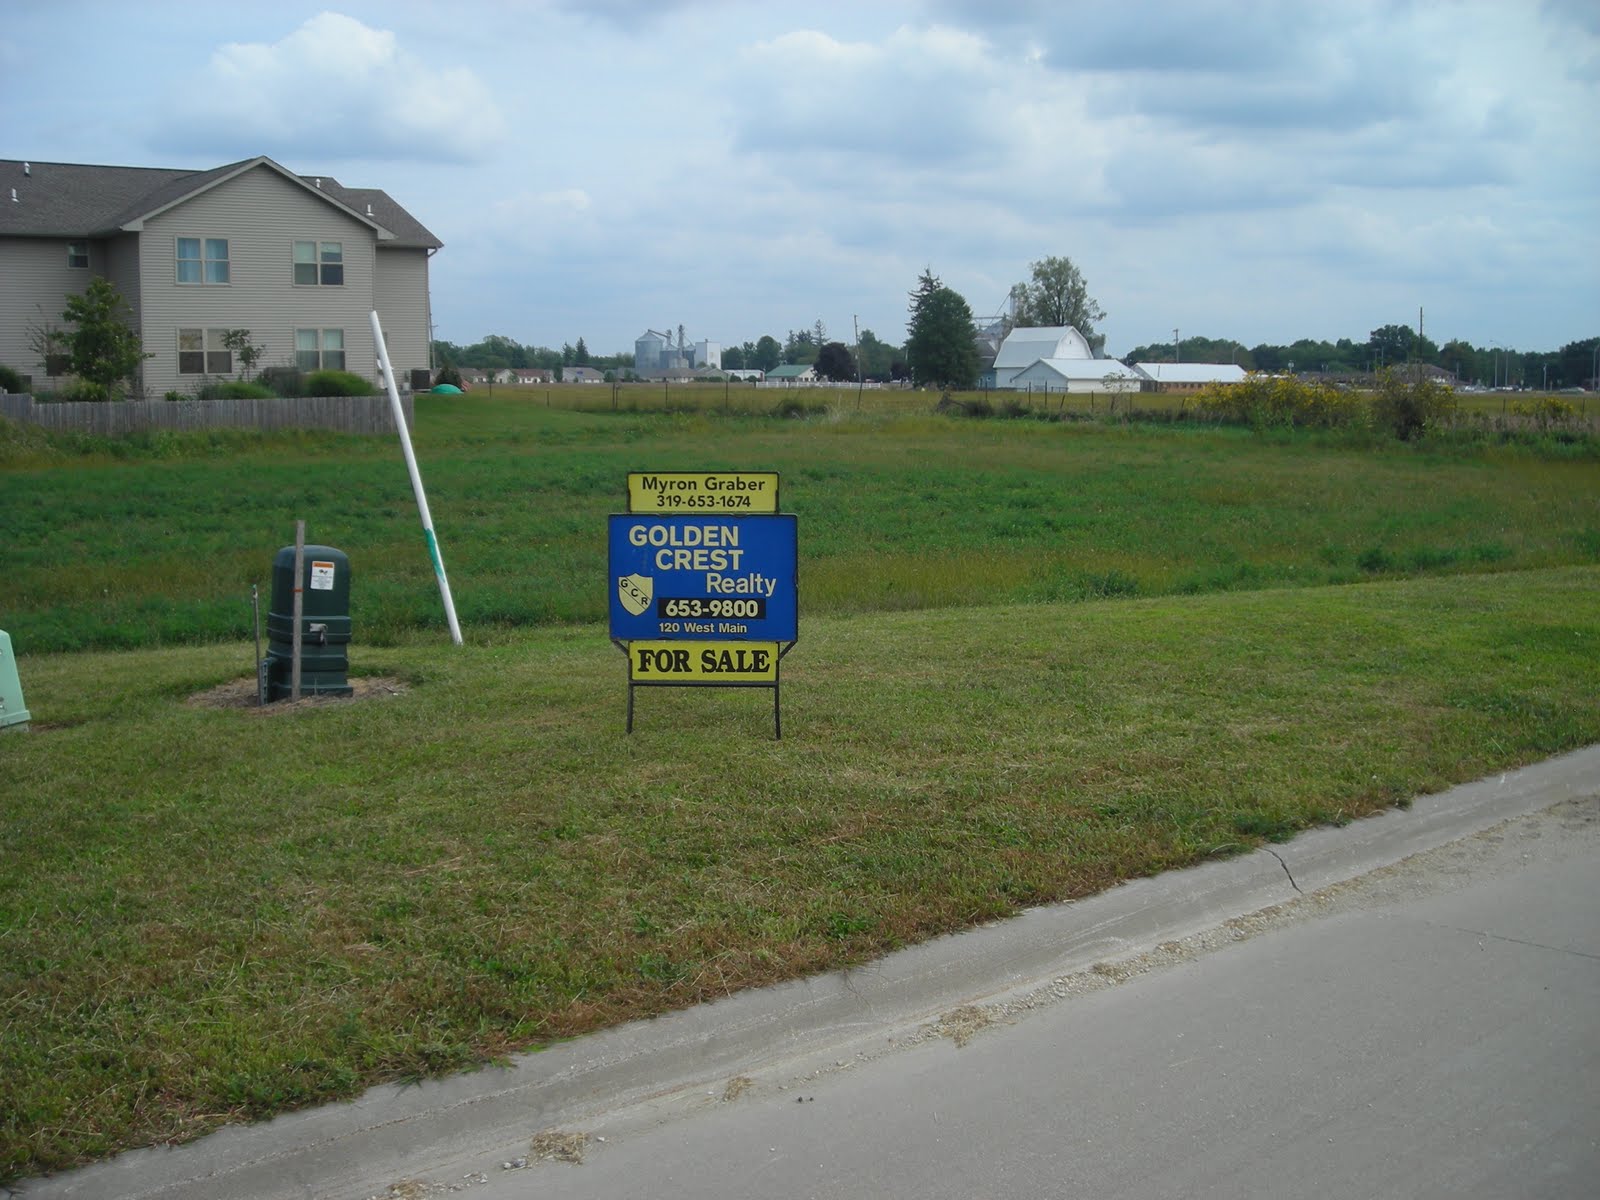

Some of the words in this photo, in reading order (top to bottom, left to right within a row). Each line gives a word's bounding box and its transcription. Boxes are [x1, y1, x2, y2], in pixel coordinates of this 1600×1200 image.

[642, 476, 697, 493] Myron
[705, 476, 765, 491] Graber
[657, 495, 751, 508] 319-653-1674
[629, 525, 739, 546] GOLDEN
[655, 549, 744, 571] CREST
[706, 573, 777, 597] Realty
[665, 600, 759, 617] 653-9800
[659, 622, 680, 633] 120
[684, 622, 715, 633] West
[719, 623, 747, 633] Main
[637, 649, 692, 673] FOR
[701, 649, 770, 673] SALE
